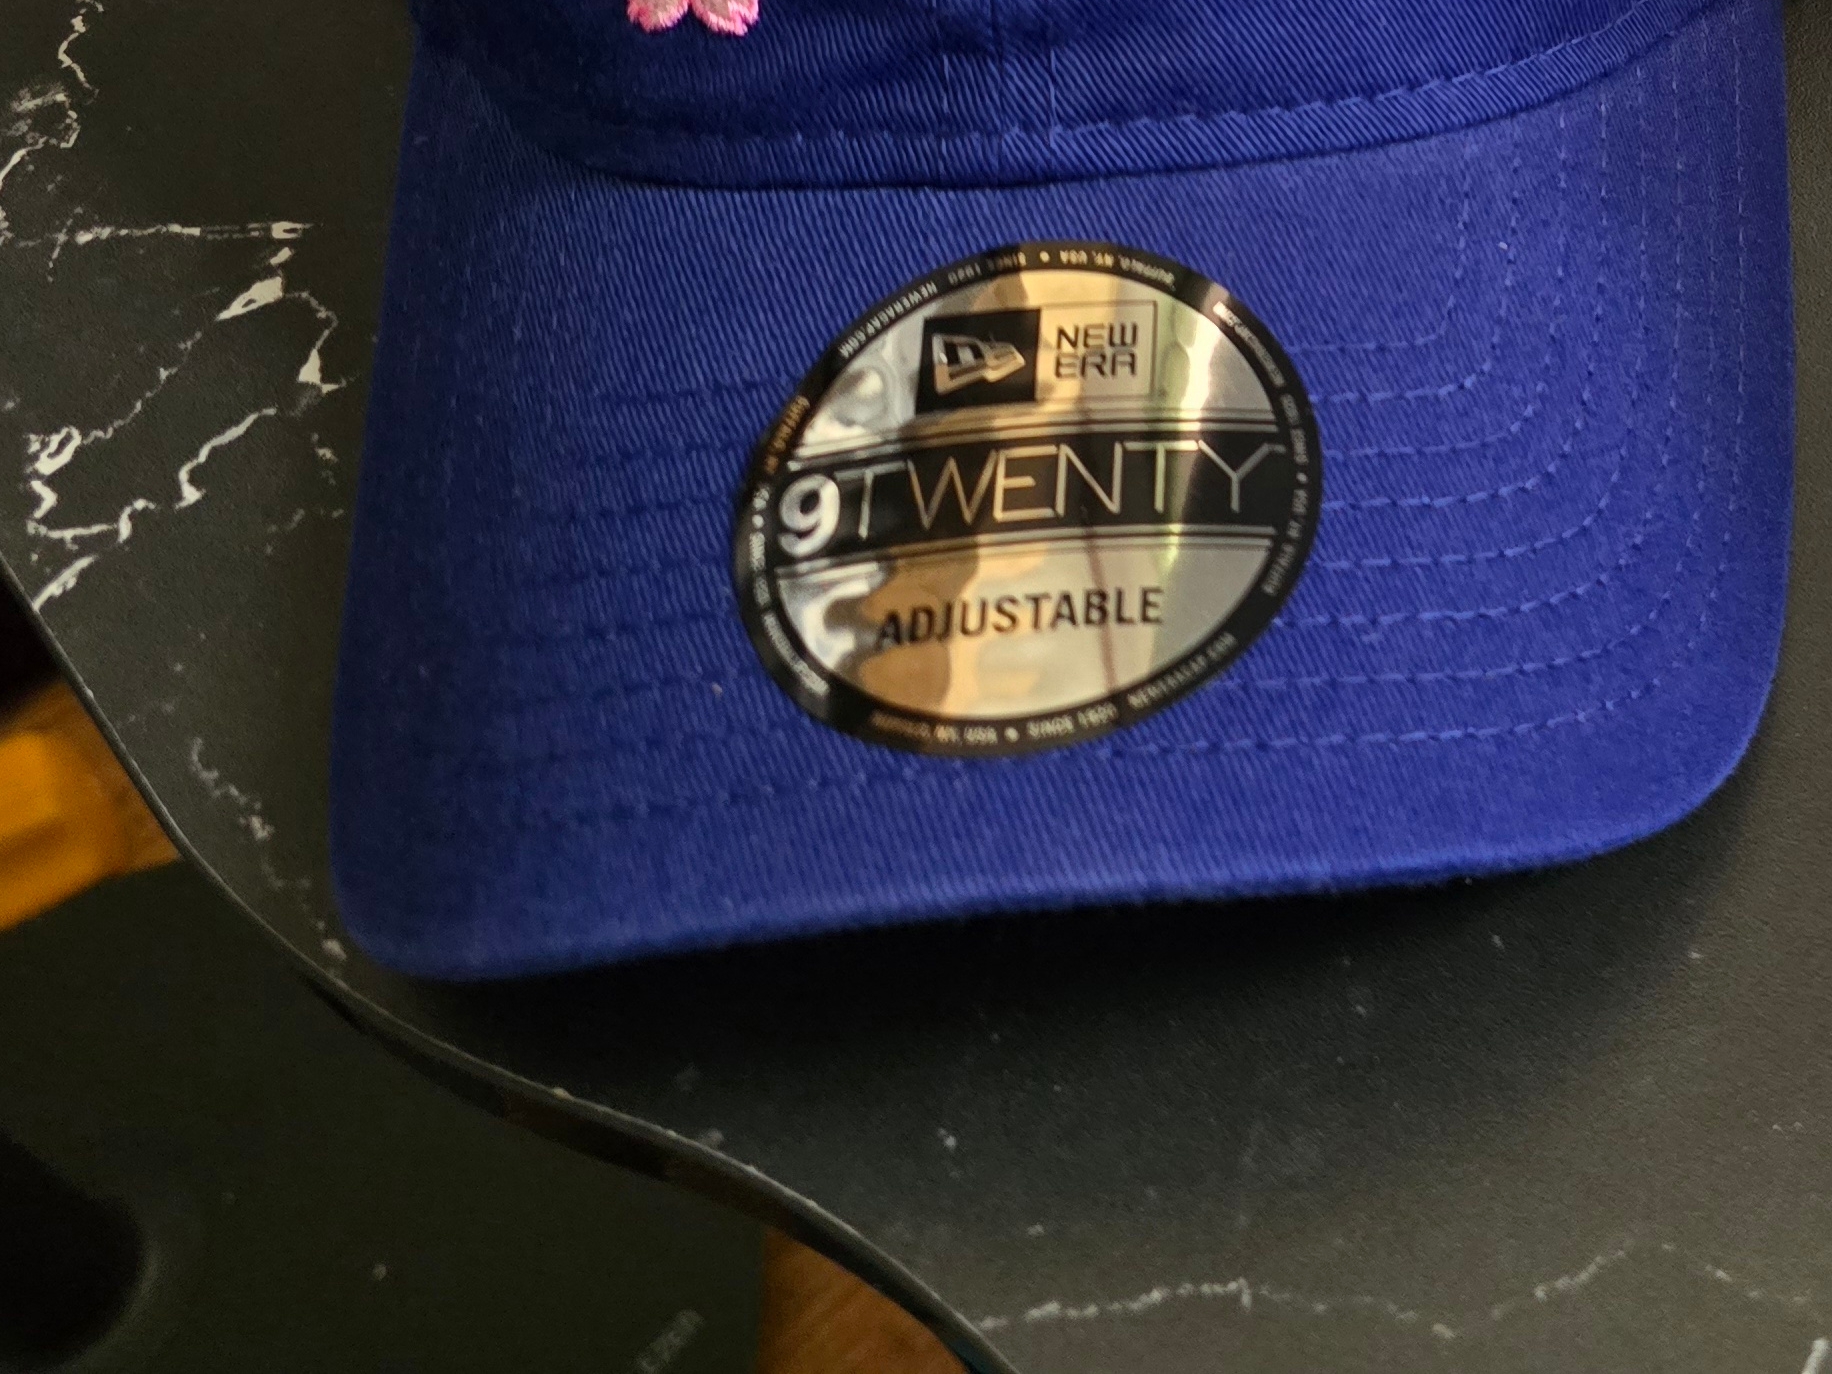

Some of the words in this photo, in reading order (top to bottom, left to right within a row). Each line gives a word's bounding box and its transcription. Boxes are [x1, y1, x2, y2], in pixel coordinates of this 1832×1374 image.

[1054, 322, 1140, 352] NEW
[1054, 351, 1140, 380] ERA
[778, 439, 1288, 557] 9TWENTY
[873, 586, 1165, 648] ADJUSTABLE
